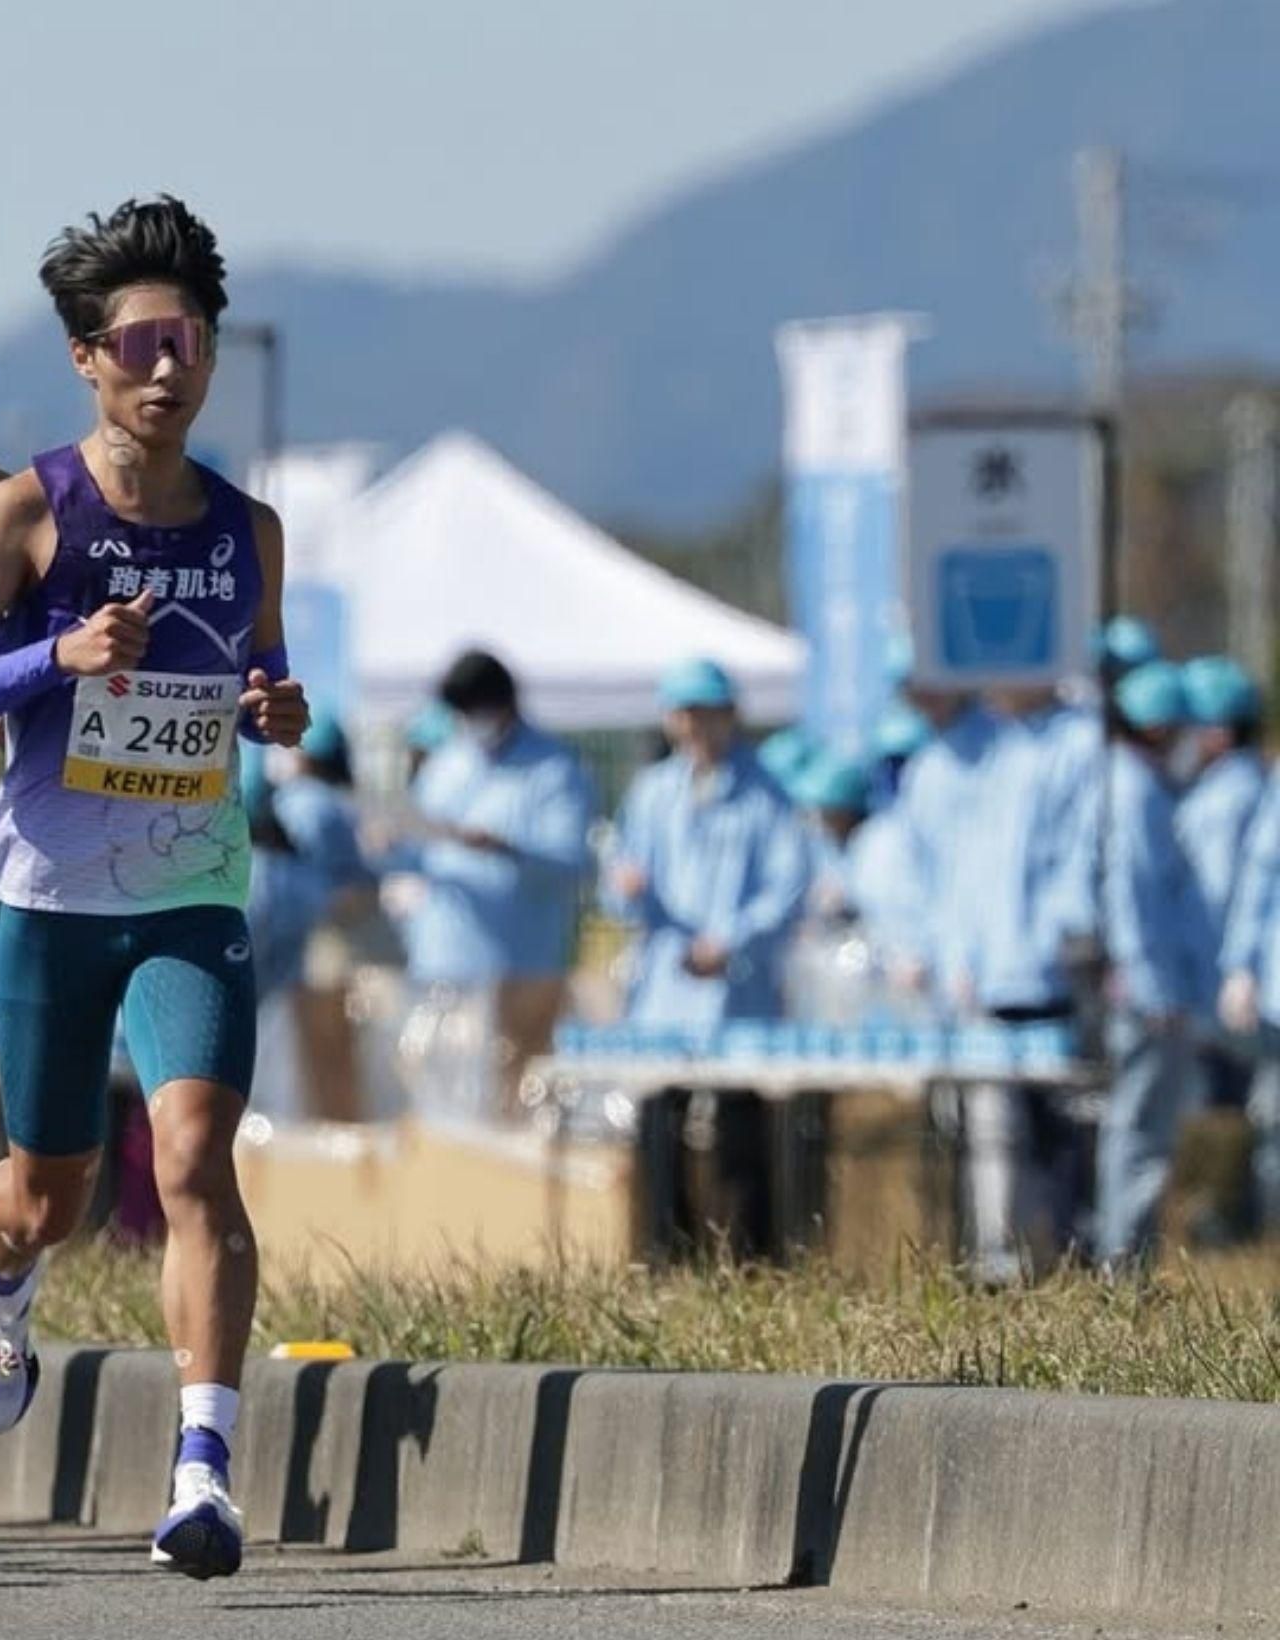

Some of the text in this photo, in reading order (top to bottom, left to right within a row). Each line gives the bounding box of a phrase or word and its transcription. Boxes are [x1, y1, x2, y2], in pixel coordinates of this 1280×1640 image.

[107, 565, 236, 601] 跑者肌地
[136, 680, 223, 701] SUZUKI
[80, 710, 105, 739] A
[125, 716, 221, 756] 2489
